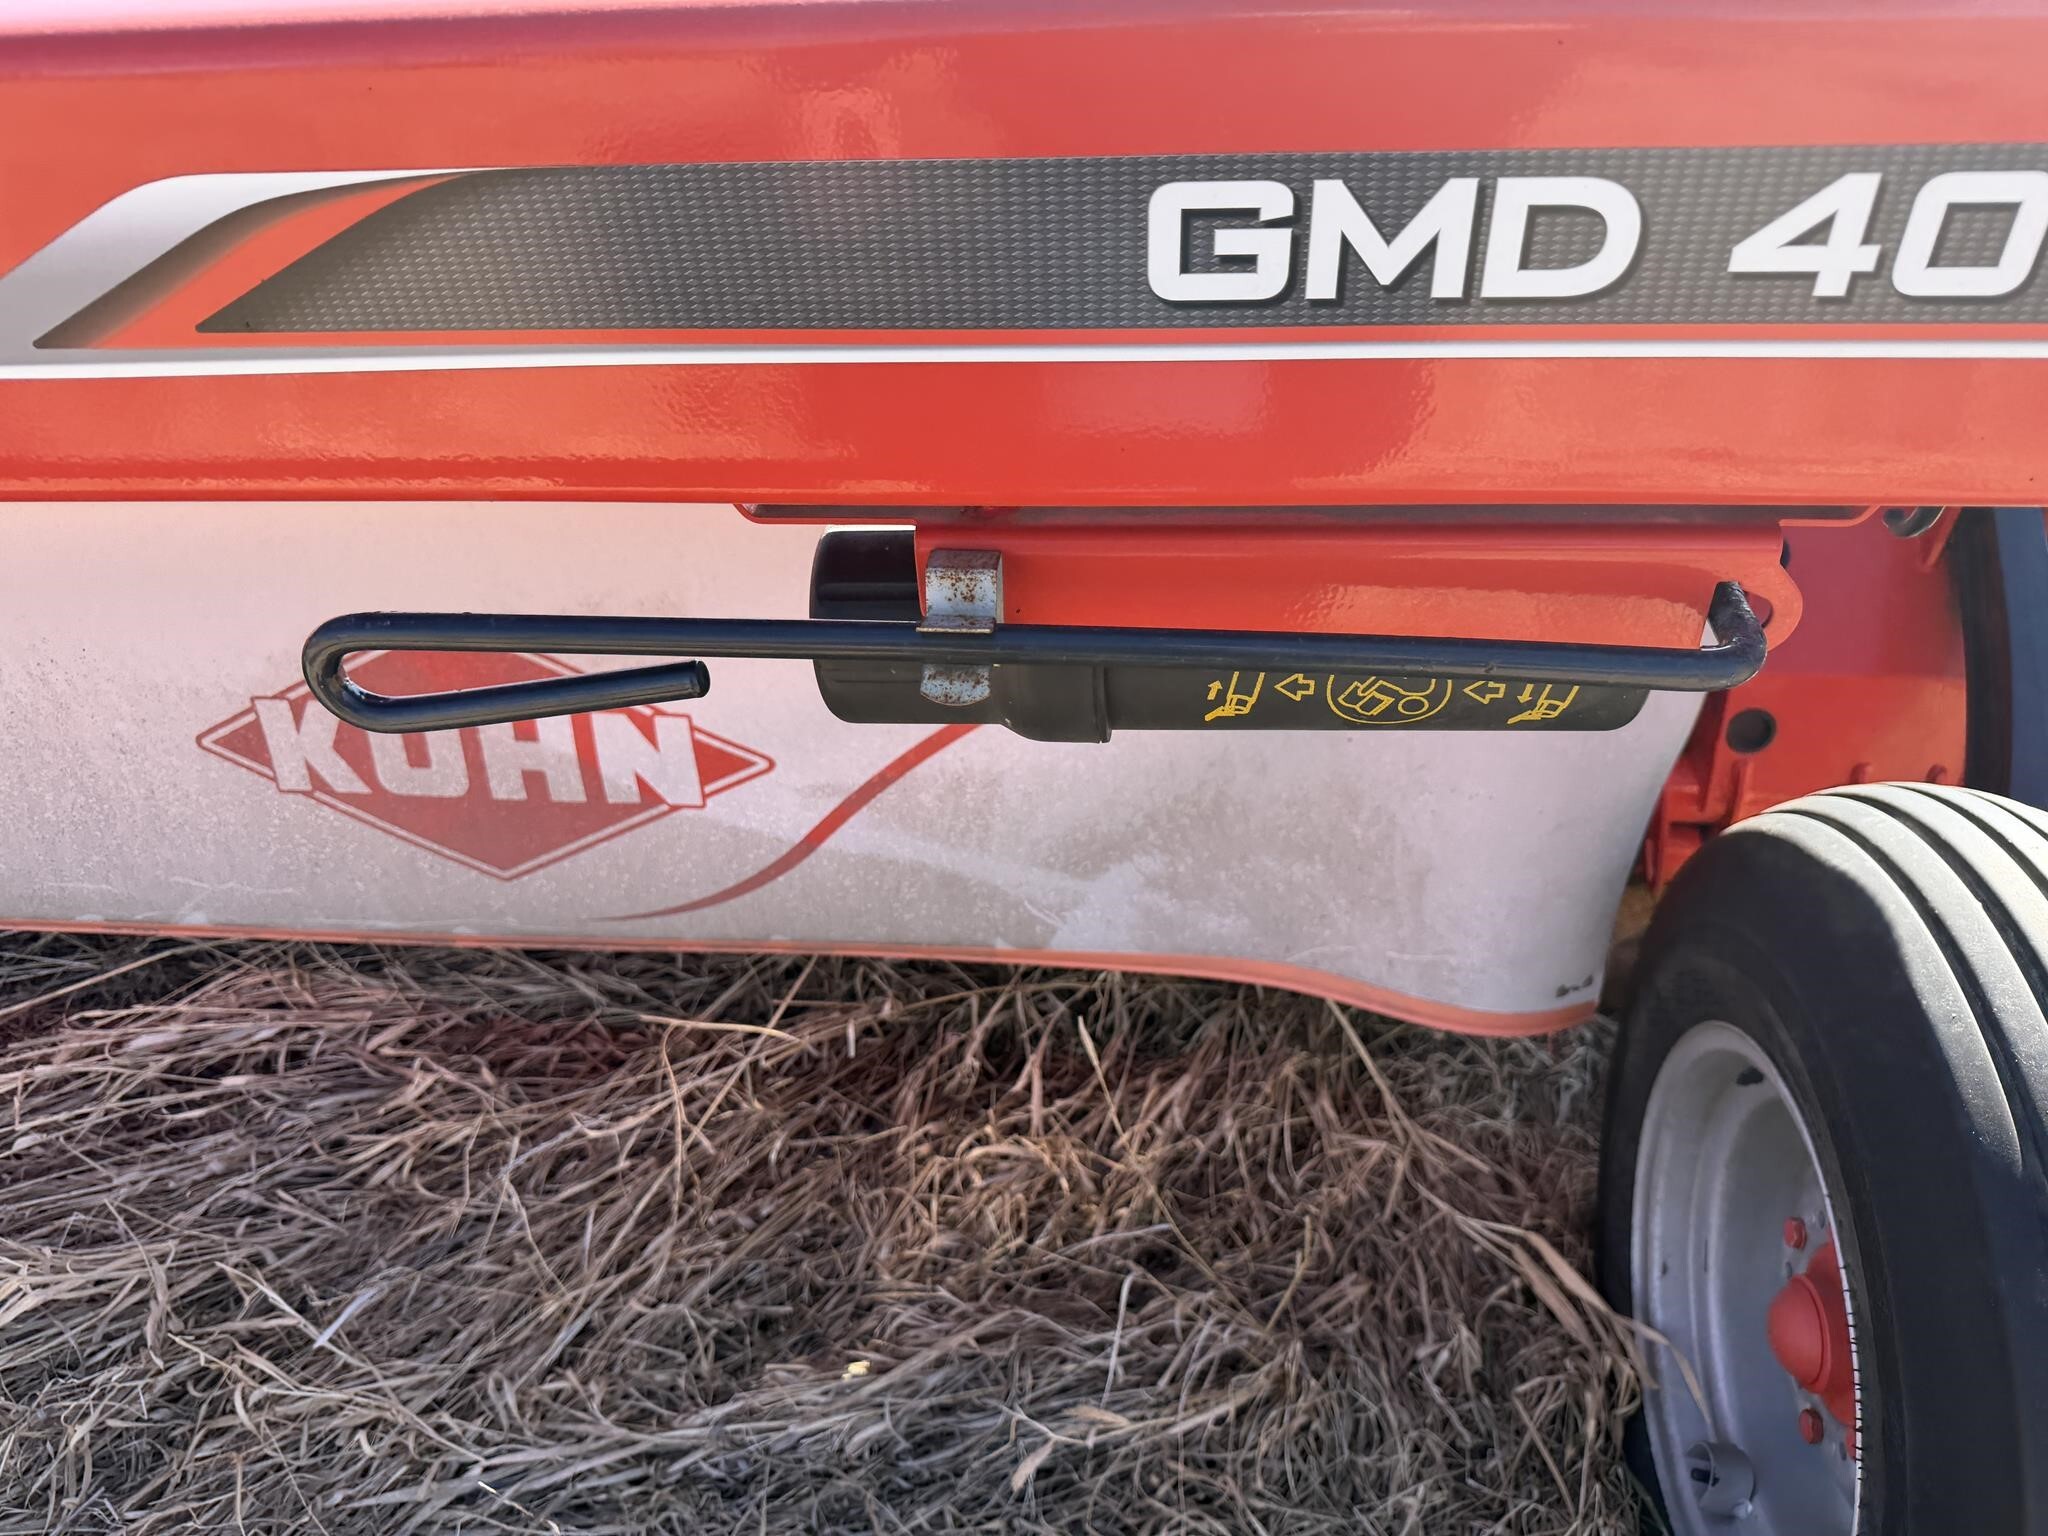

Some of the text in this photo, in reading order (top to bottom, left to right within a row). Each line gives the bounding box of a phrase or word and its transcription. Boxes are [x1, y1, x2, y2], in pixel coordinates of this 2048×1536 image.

[1148, 171, 2048, 302] GMD 40
[252, 697, 704, 807] KUHN
